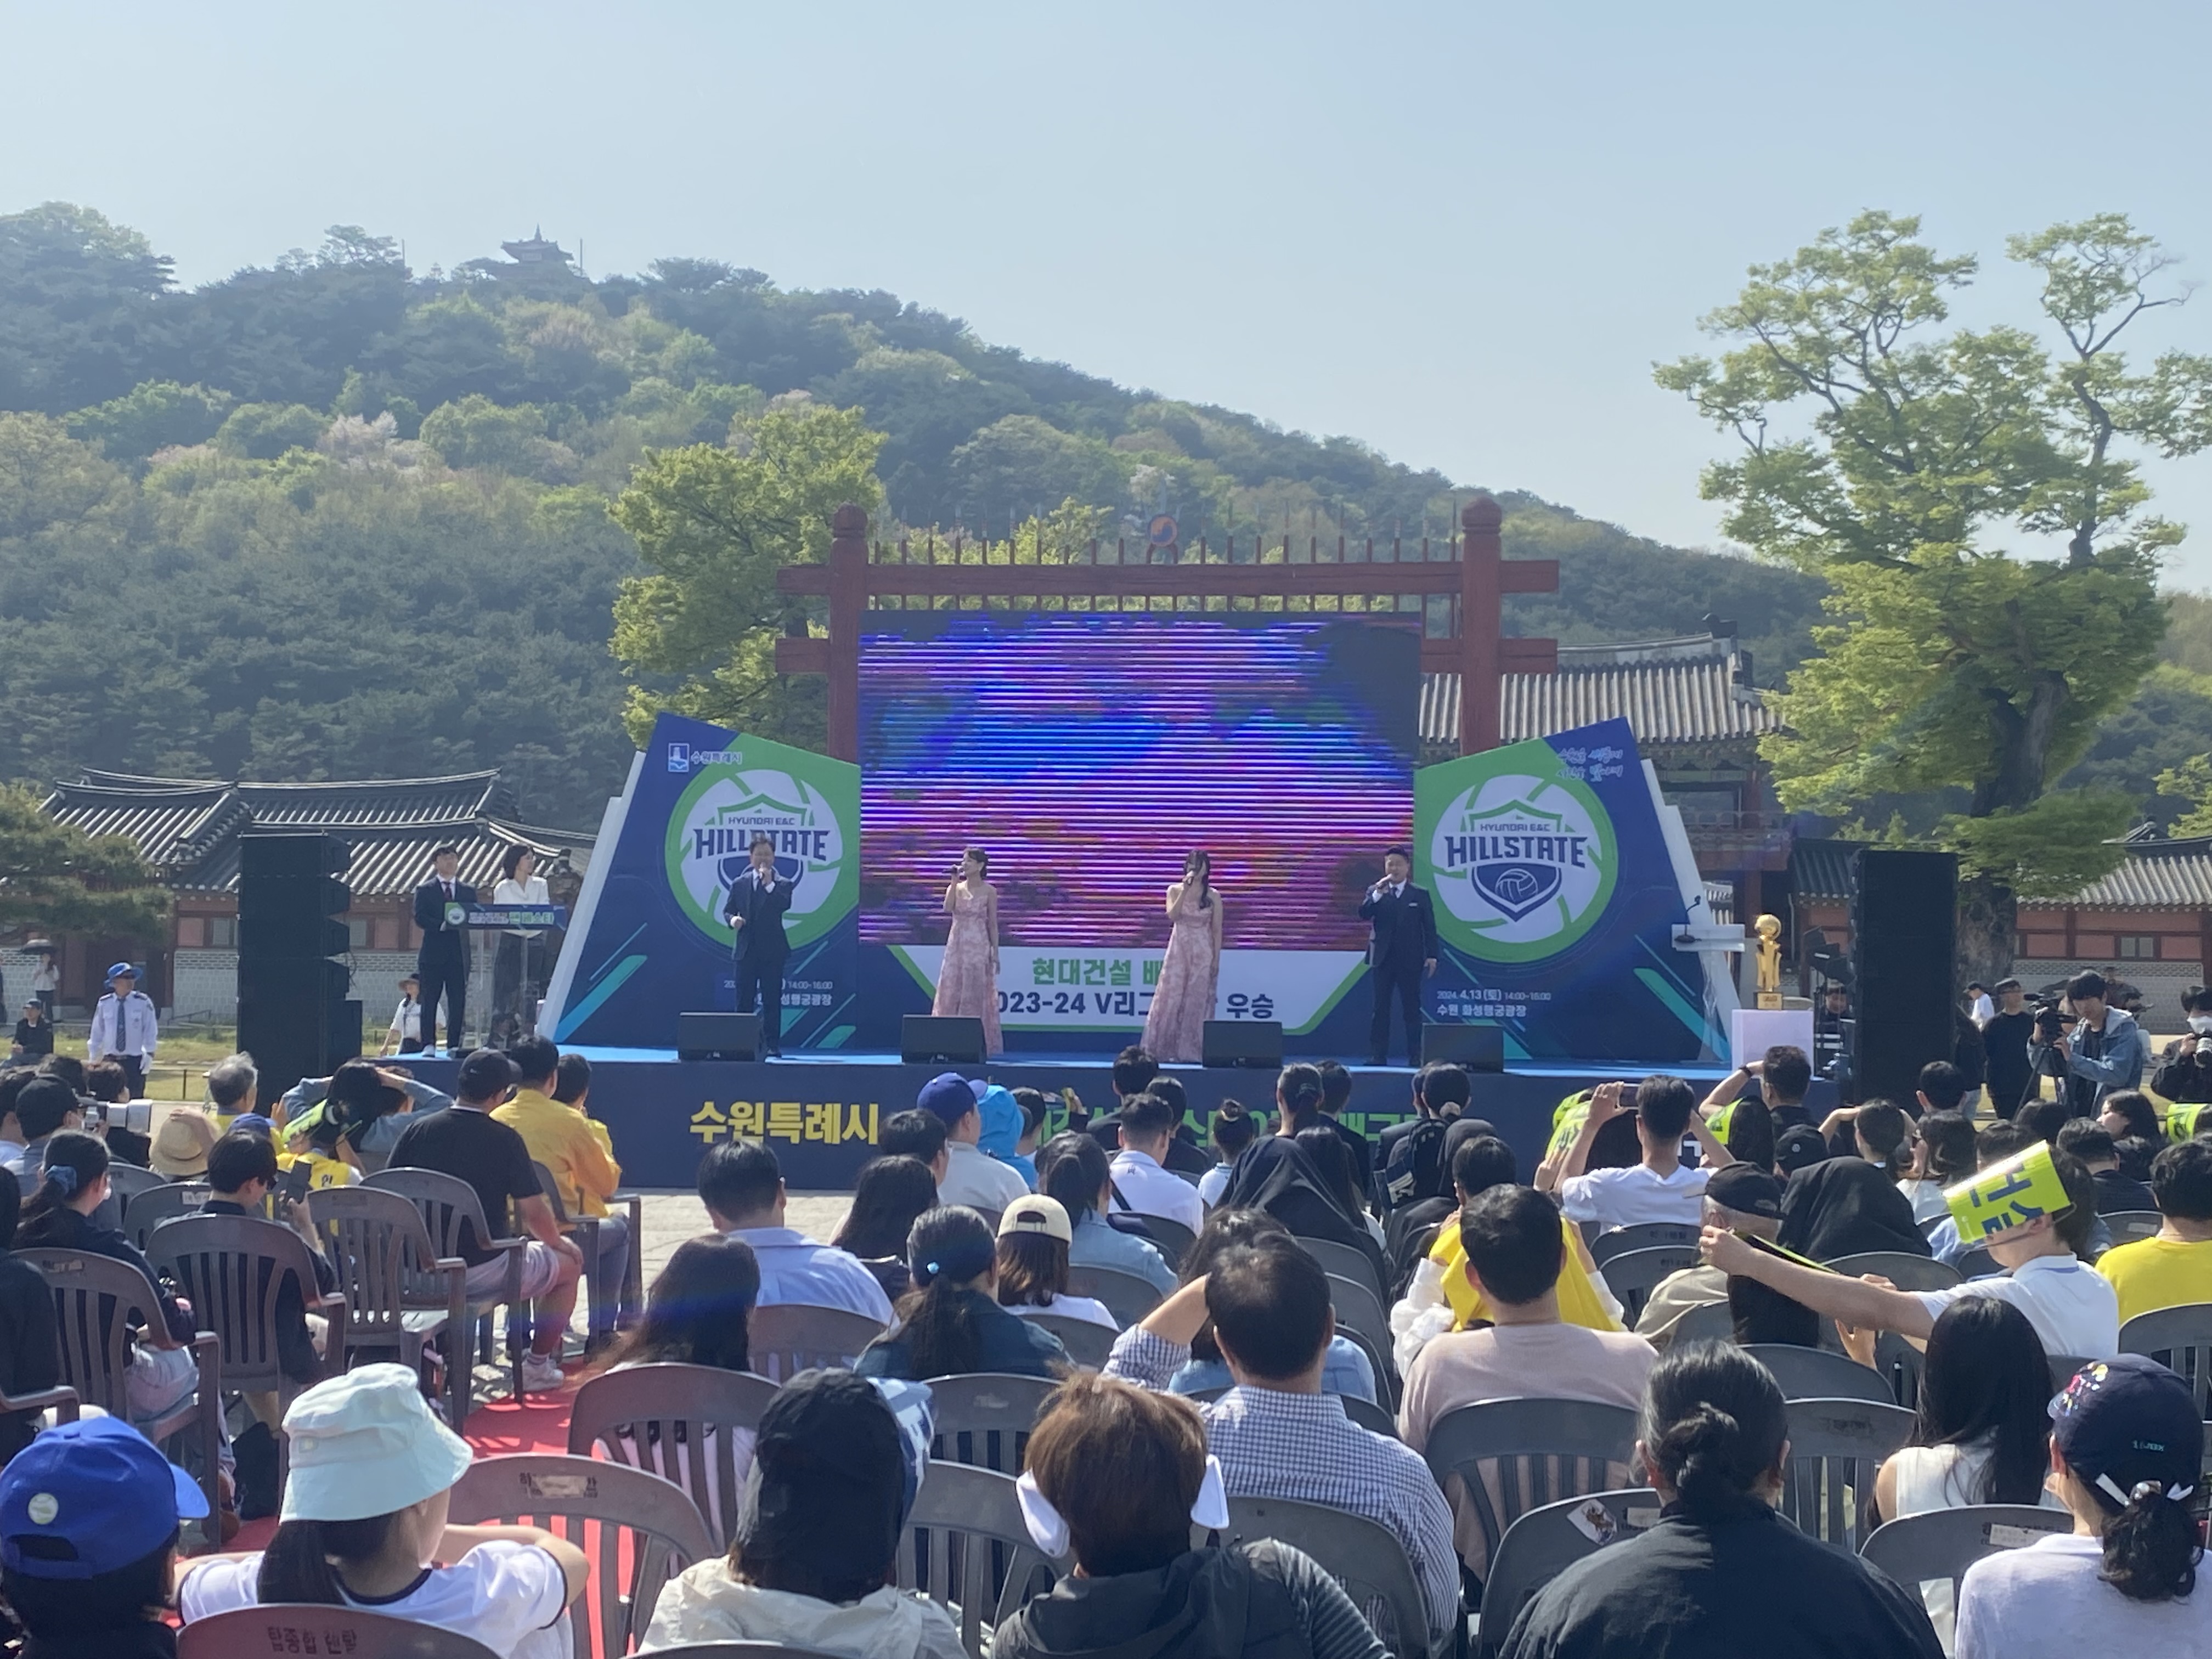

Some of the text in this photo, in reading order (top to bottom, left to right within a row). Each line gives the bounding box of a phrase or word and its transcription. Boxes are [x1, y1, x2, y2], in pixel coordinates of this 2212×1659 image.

[691, 751, 742, 764] 수원특례시
[728, 817, 795, 825] HYUNDAI E&C
[1444, 836, 1588, 868] HILLSTATE
[1032, 958, 1131, 986] 현대건설
[781, 994, 832, 1006] 성행궁광장
[998, 991, 1086, 1015] 023-24
[1227, 994, 1275, 1019] 우승
[1437, 1004, 1527, 1017] 수원 화성행궁광장
[690, 1100, 878, 1146] 수원특례시
